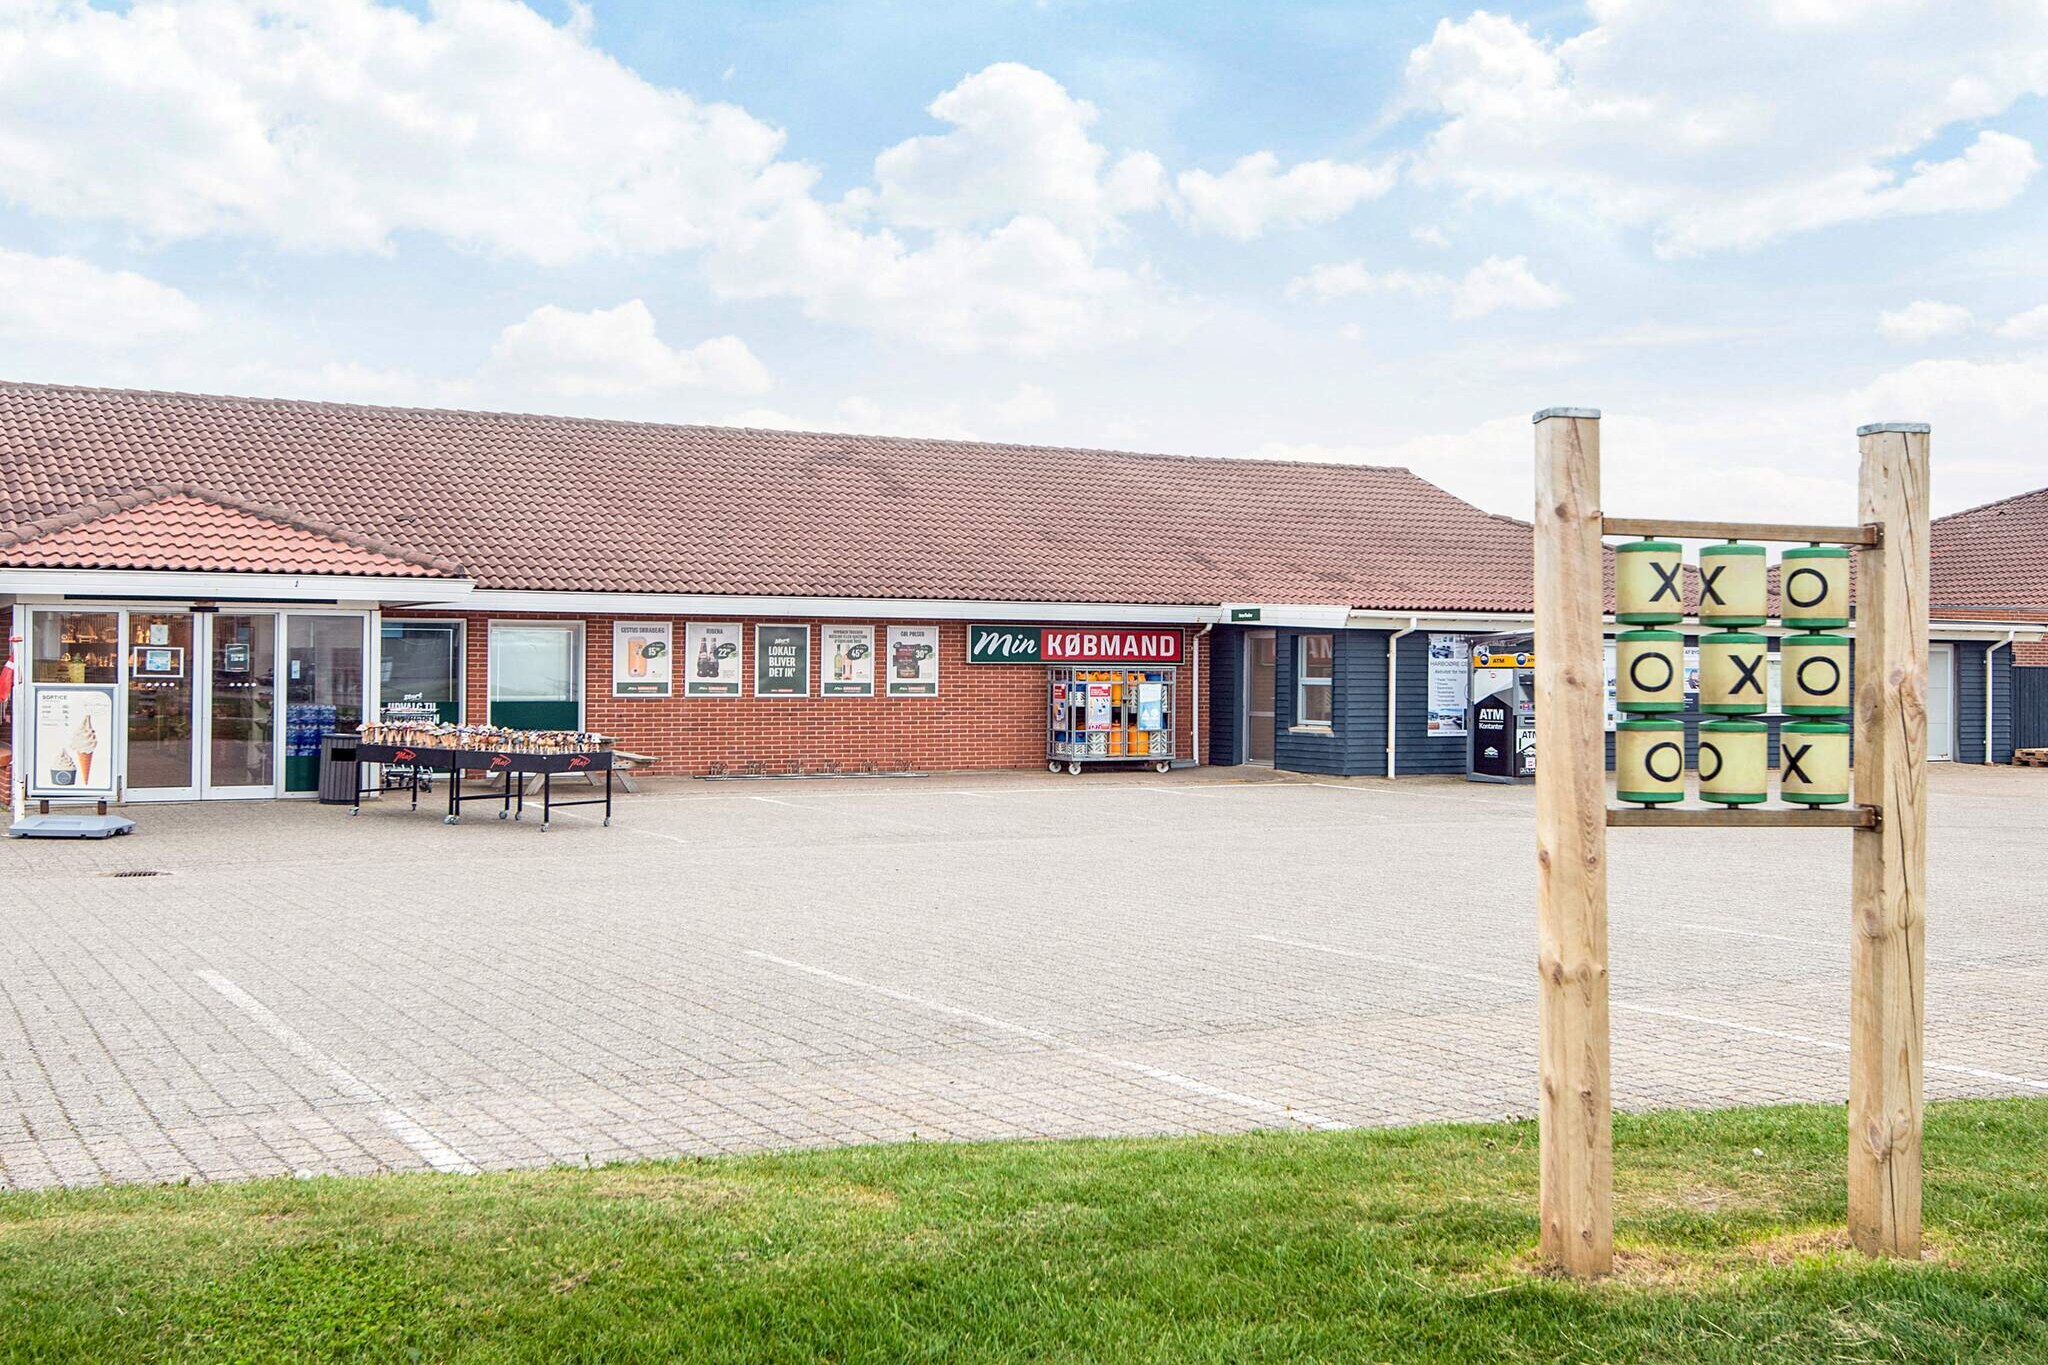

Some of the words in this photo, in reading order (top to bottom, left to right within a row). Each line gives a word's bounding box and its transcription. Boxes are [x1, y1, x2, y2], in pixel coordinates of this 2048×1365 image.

[1648, 562, 1682, 603] X
[1699, 565, 1727, 606] X
[1786, 567, 1829, 608] O
[973, 632, 1038, 657] Min
[1047, 633, 1175, 657] KØBMAND
[768, 646, 797, 656] LOKALT
[768, 657, 796, 667] BLIVER
[768, 668, 784, 677] DET
[1630, 651, 1674, 693] O
[1727, 654, 1764, 695] X
[1796, 655, 1841, 696] O
[1479, 708, 1504, 720] ATM
[1478, 722, 1504, 730] Kontanter
[1781, 743, 1813, 784] X
